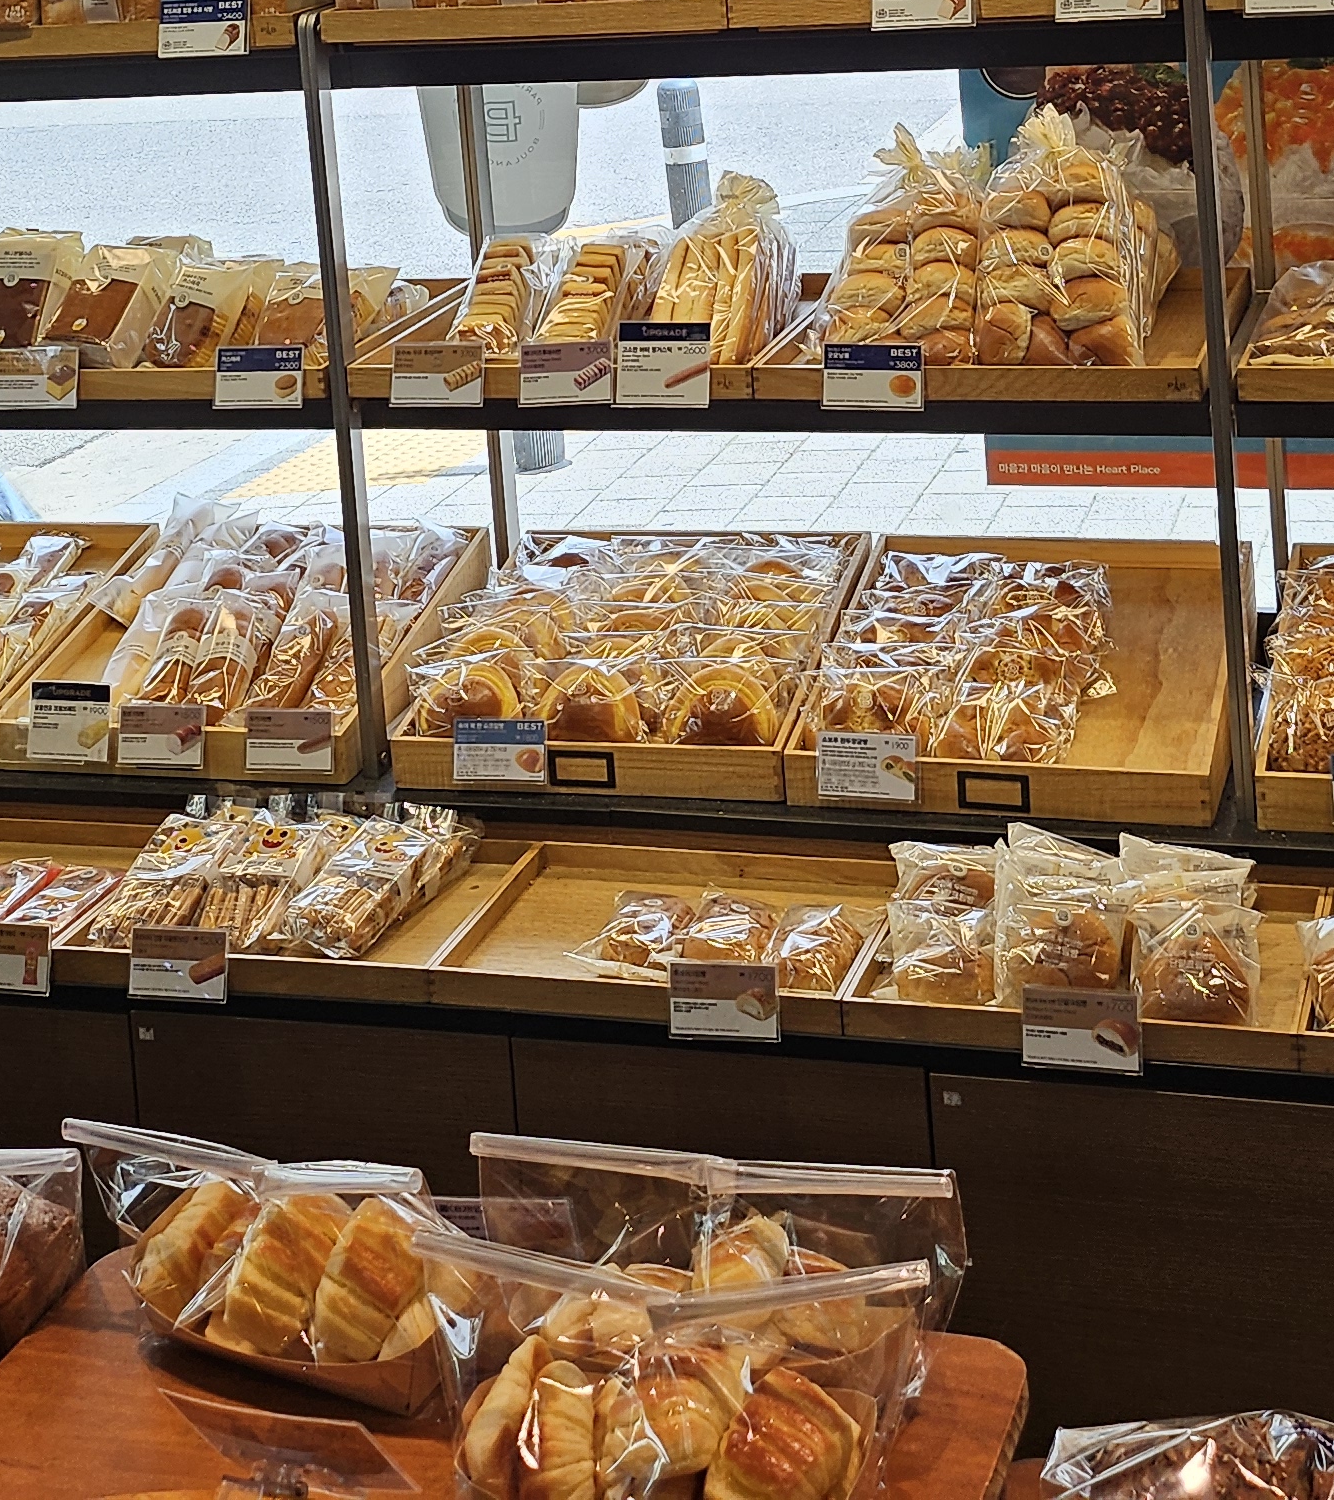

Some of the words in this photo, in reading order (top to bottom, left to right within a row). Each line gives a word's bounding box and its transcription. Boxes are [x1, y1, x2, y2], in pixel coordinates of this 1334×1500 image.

[218, 1, 244, 9] BEST
[275, 350, 300, 358] BEST
[890, 348, 918, 357] BEST
[998, 463, 1028, 474] 마음과
[1030, 463, 1060, 474] 마음이
[1063, 464, 1093, 475] 만나는
[1096, 465, 1127, 474] Heart
[1130, 465, 1161, 475] Place
[516, 721, 543, 731] BEST
